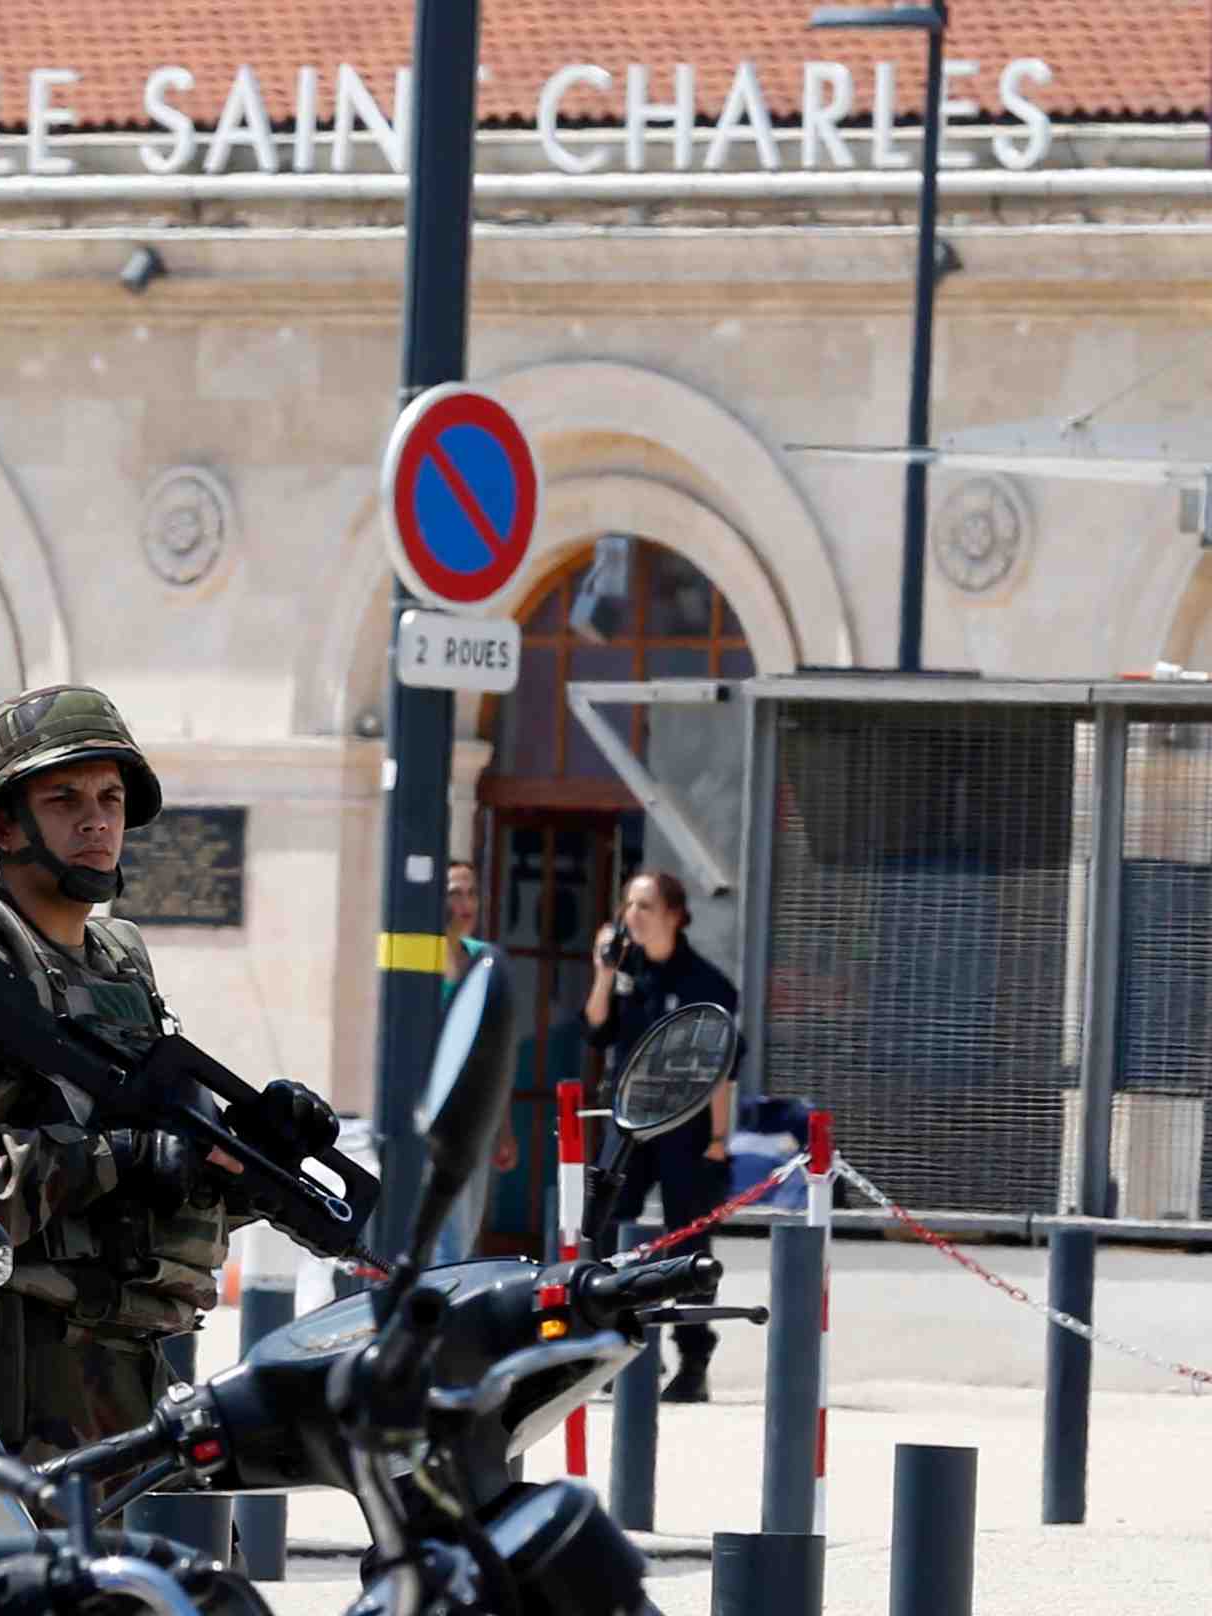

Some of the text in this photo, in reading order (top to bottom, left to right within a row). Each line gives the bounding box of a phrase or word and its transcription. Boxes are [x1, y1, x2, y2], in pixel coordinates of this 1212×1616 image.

[140, 63, 490, 174] SAIN
[536, 58, 1052, 173] CHARLES
[415, 634, 510, 669] 2 ROUES
